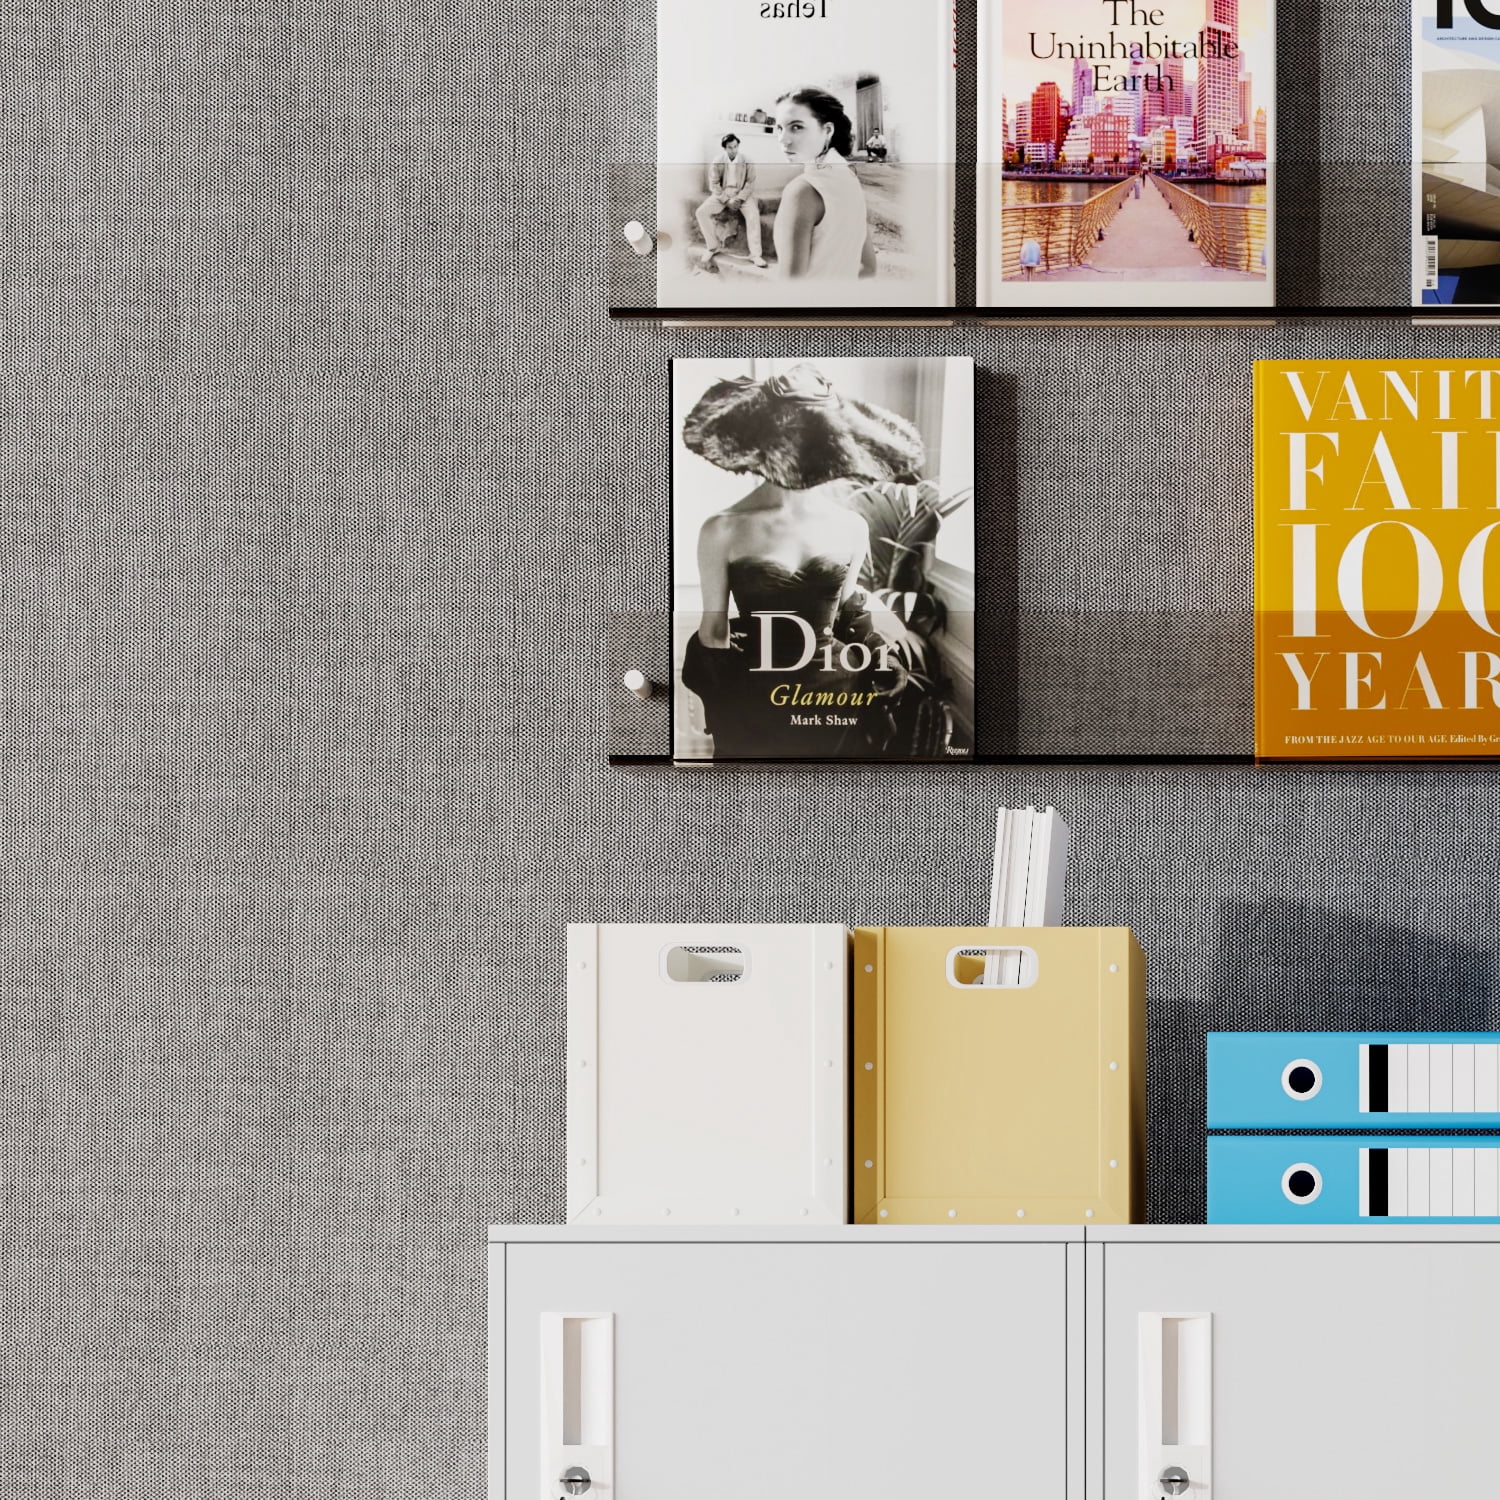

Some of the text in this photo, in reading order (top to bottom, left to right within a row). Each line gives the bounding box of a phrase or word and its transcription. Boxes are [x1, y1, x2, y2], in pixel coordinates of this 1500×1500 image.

[1102, 0, 1165, 26] The
[1028, 31, 1239, 59] Uninhabitable
[1092, 64, 1174, 92] Earth
[749, 610, 899, 673] Dior
[770, 684, 878, 707] Glamour
[790, 714, 858, 726] Mark Shaw
[1284, 735, 1314, 744] FROM
[1316, 735, 1337, 744] THE
[1338, 735, 1364, 744] JAZZ
[1367, 735, 1386, 744] AGE
[1388, 735, 1402, 744] TO
[1403, 735, 1425, 743] OUR
[1428, 735, 1447, 743] AGE
[1449, 734, 1476, 743] Edited
[1478, 734, 1488, 746] By
